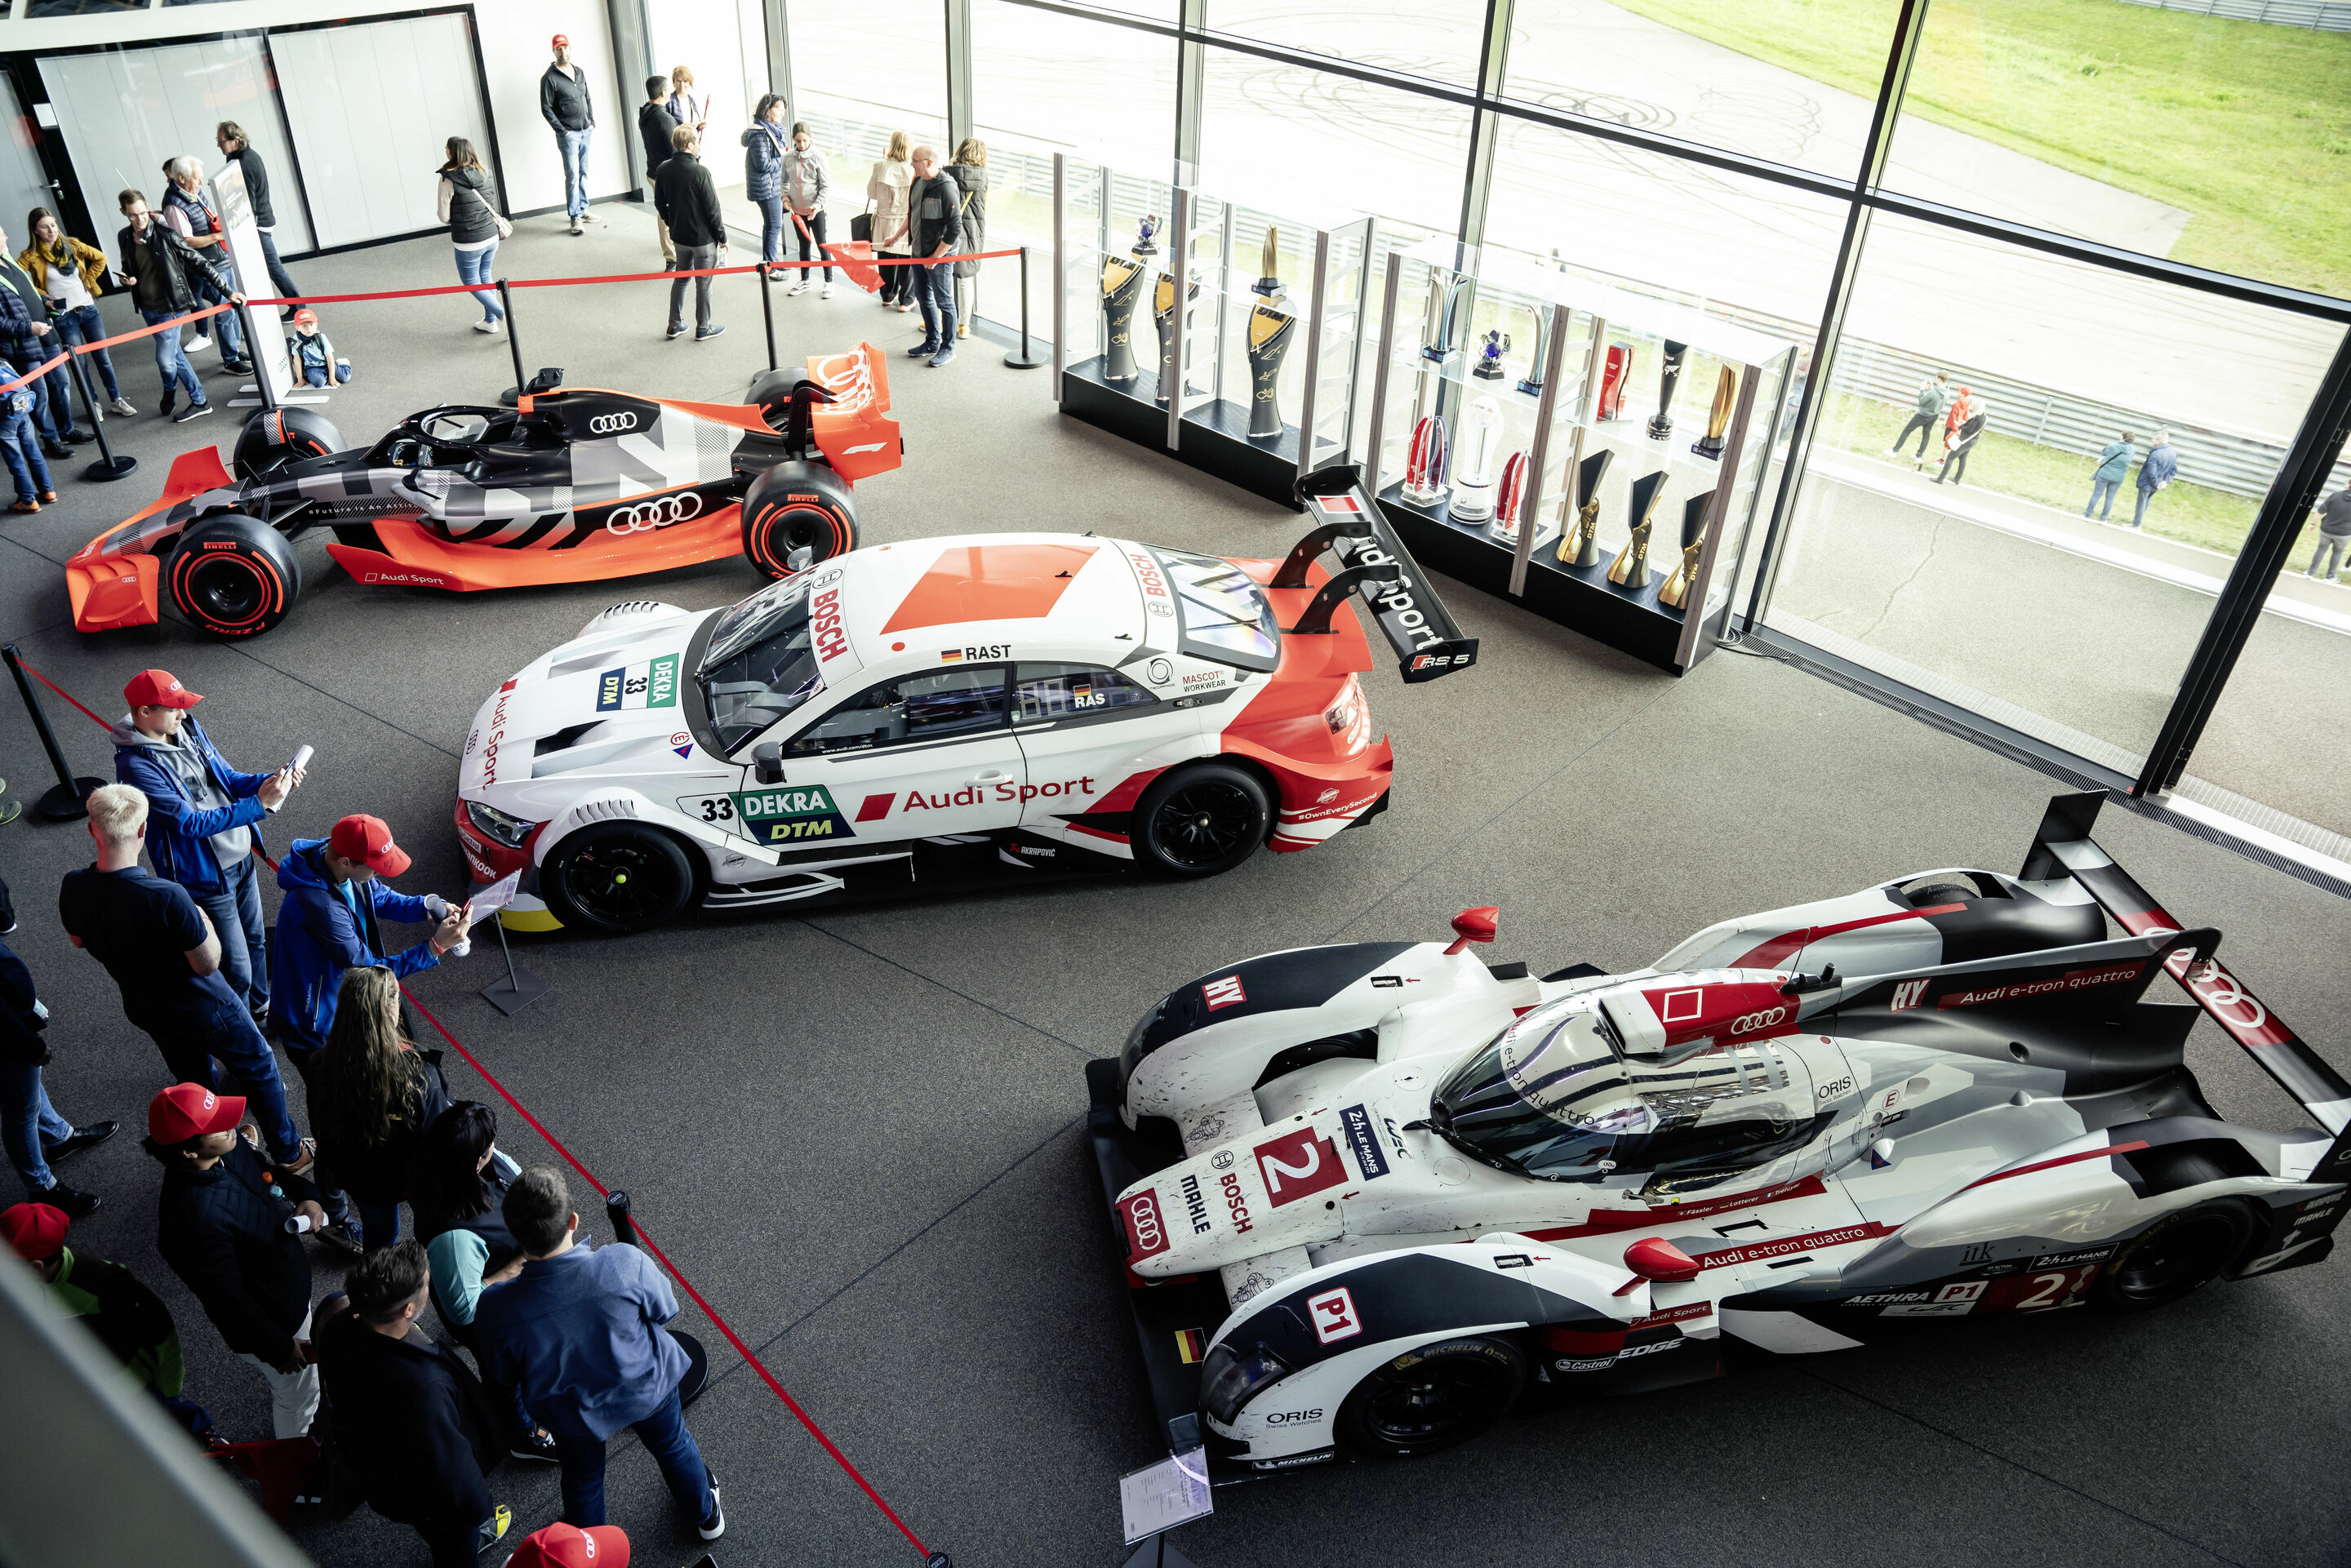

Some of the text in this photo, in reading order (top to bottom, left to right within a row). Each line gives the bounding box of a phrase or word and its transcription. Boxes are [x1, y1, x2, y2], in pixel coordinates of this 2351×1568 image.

[788, 494, 819, 502] PIRELLI
[309, 507, 351, 515] #Future
[1587, 522, 1596, 540] DTM
[1638, 543, 1647, 560] DTM
[380, 573, 444, 584] Audi Sport
[1130, 553, 1167, 597] BOSCH
[814, 589, 848, 663] BOSCH
[966, 645, 1011, 661] RAST
[1453, 654, 1470, 664] 5
[602, 677, 620, 704] DTM
[624, 677, 647, 695] 33
[653, 661, 673, 703] DEKRA
[1184, 679, 1226, 692] WORKWEAR
[1075, 693, 1105, 708] RAS
[482, 695, 513, 791] Audi Sport
[822, 744, 873, 754] www.audi.com/dtm
[903, 775, 1095, 813] Audi Sport
[701, 790, 827, 822] 33 DEKRA
[1299, 792, 1377, 820] #OwnEverySecond
[771, 820, 833, 840] DTM
[1205, 976, 1243, 1006] HY
[1891, 979, 1930, 1011] HY
[1960, 969, 2135, 1005] Audi e-tron quattro
[1504, 1047, 1528, 1090] e-tron
[1528, 1090, 1595, 1126] quattro
[1819, 1076, 1851, 1099] ORIS
[1885, 1091, 1897, 1108] E
[1356, 1131, 1368, 1145] LE
[1362, 1144, 1380, 1174] MANS
[1261, 1142, 1320, 1194] 2
[1180, 1174, 1211, 1235] MAHLE
[1220, 1172, 1254, 1235] BOSCH
[1687, 1182, 1801, 1215] Fässler Lotterer Tréluyer
[2293, 1207, 2335, 1227] MAHLE
[1704, 1228, 1865, 1268] Audi e-tron quattro
[1962, 1241, 1997, 1263] itk
[2061, 1255, 2077, 1263] LE
[2078, 1250, 2109, 1260] MANS
[1844, 1291, 1931, 1304] AETHRA
[1942, 1285, 1980, 1300] P1
[2015, 1273, 2065, 1309] 2
[1315, 1296, 1353, 1334] P1
[1642, 1305, 1708, 1322] Audi Sport
[1424, 1345, 1482, 1357] MICHELIN
[1618, 1337, 1687, 1359] EDGE
[1571, 1358, 1613, 1370] Castrol
[1266, 1408, 1323, 1424] ORIS
[1290, 1418, 1322, 1427] Watches
[1278, 1453, 1331, 1466] MICHELIN
